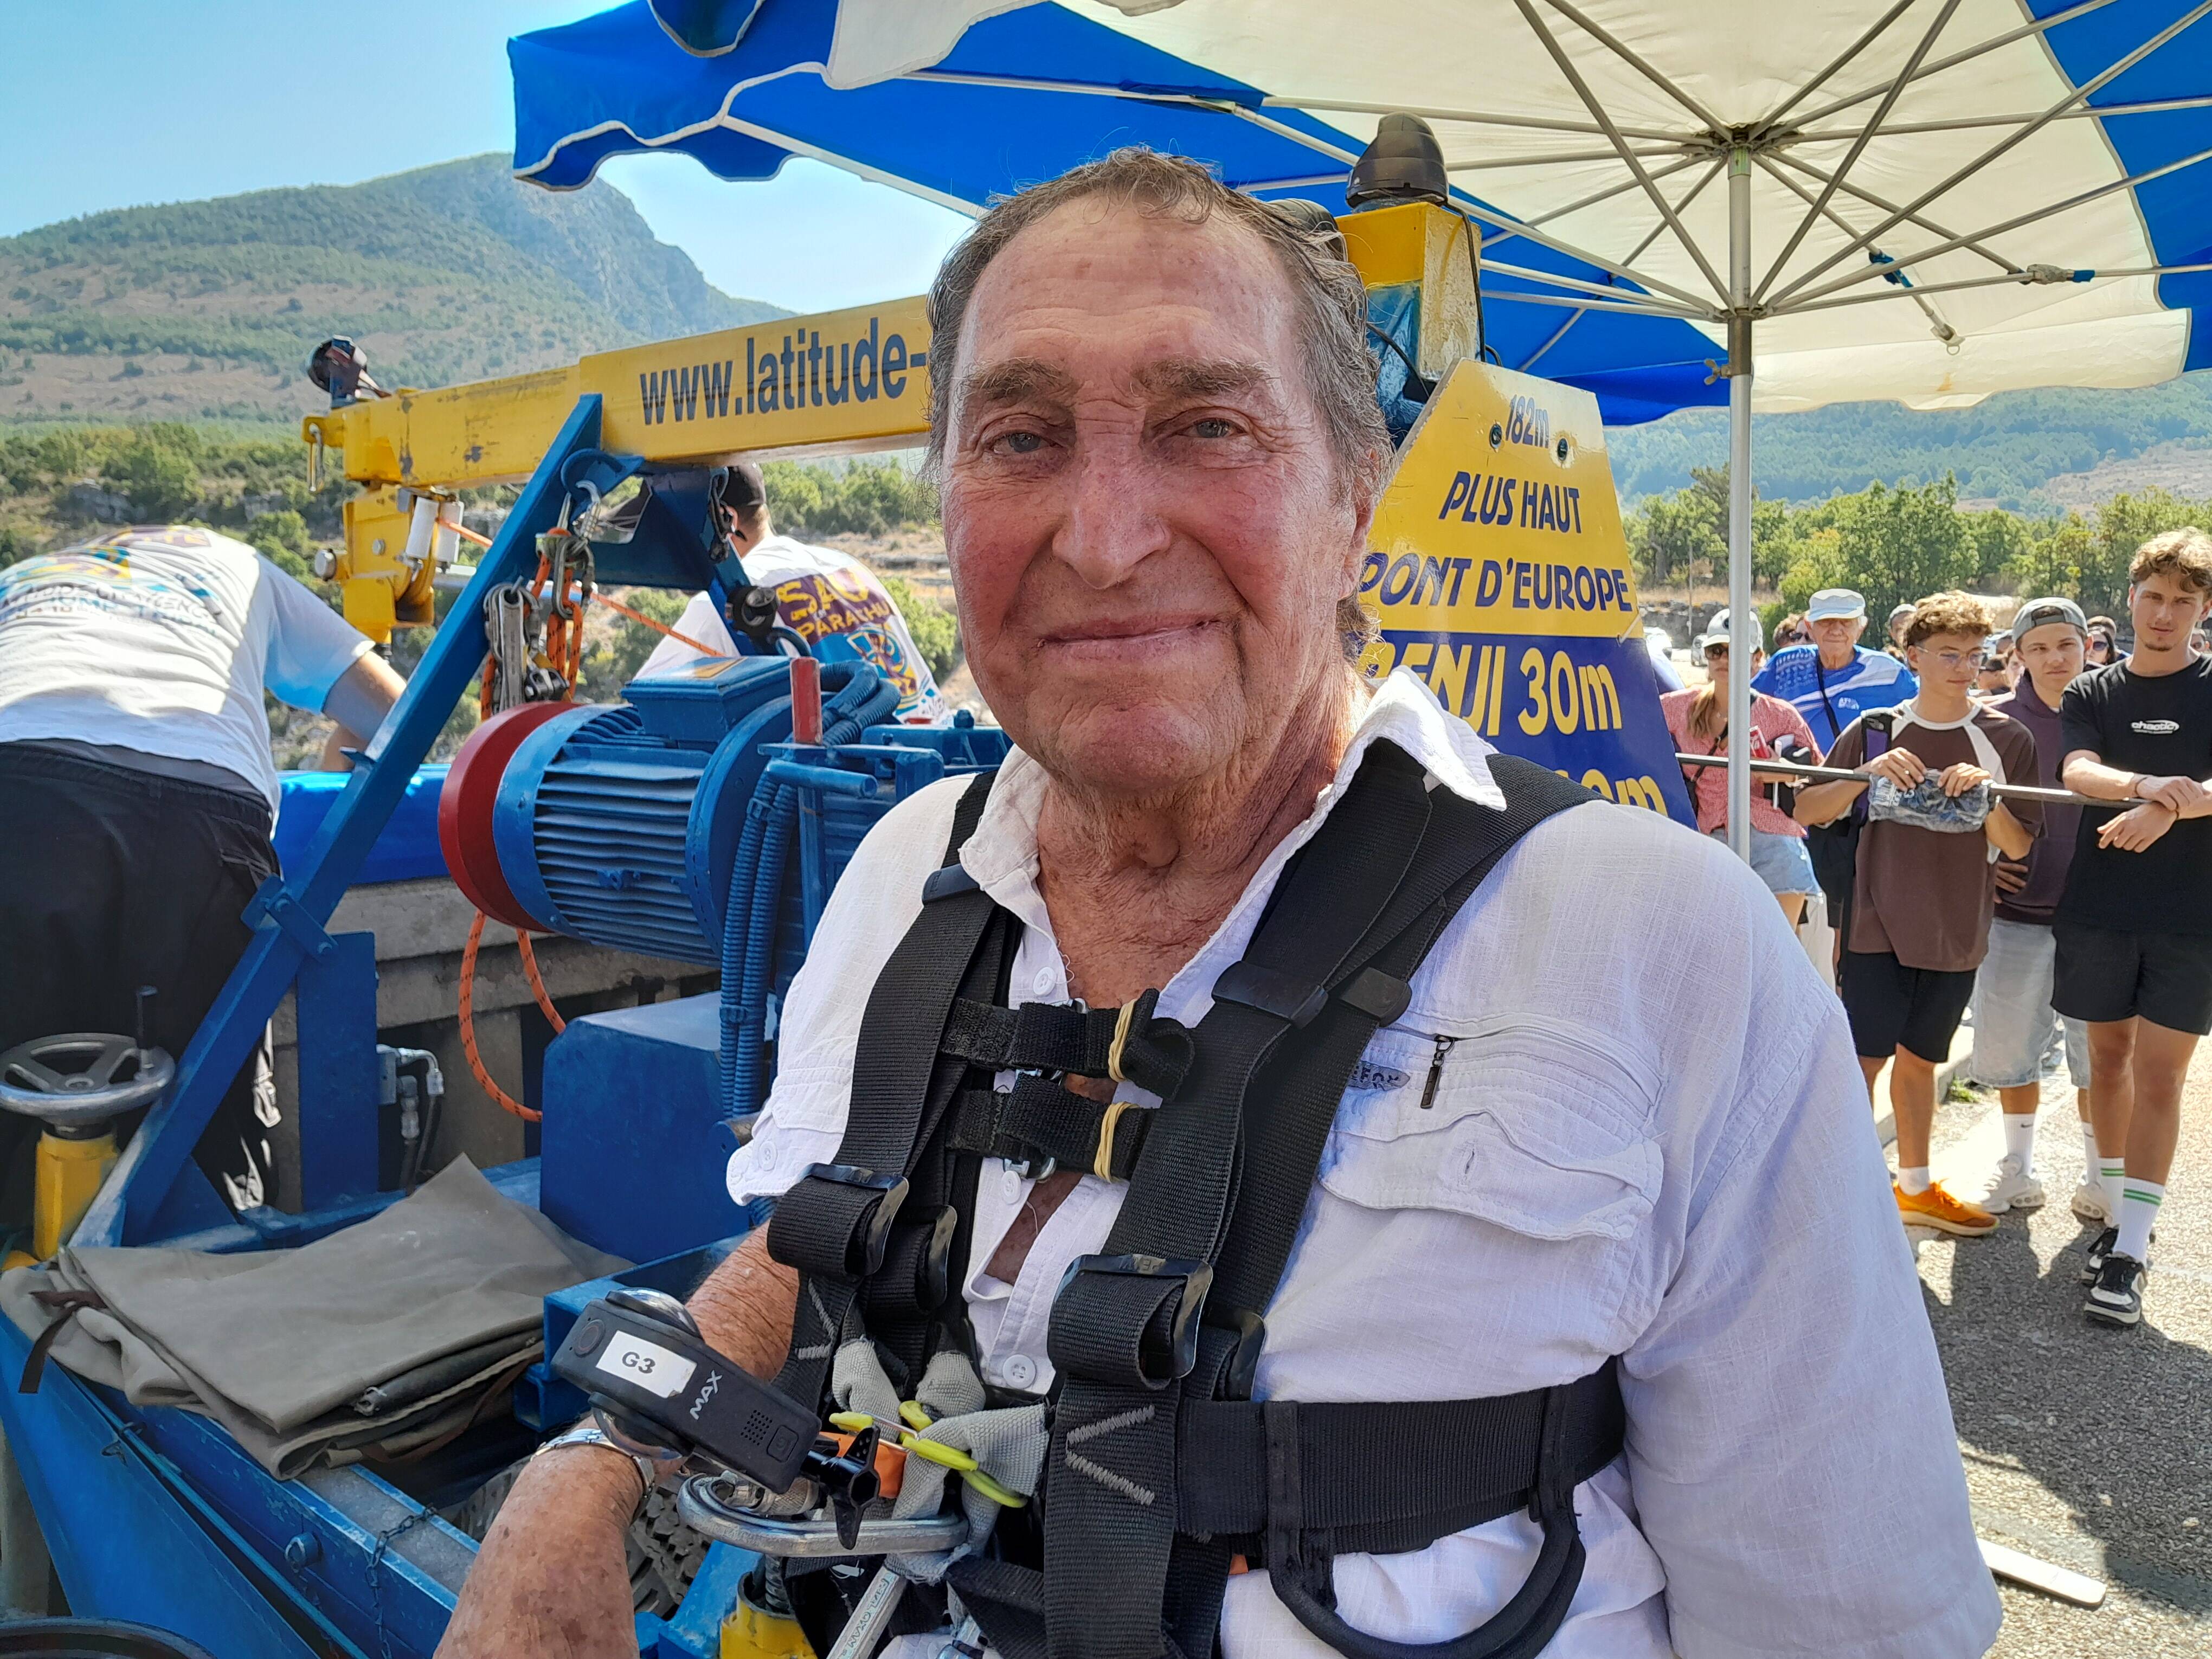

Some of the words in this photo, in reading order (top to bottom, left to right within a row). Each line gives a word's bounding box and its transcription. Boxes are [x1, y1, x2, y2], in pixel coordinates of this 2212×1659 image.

[1506, 394, 1549, 449] 182m
[1438, 471, 1516, 525] PLUS
[1520, 480, 1581, 533] HAUT
[1359, 552, 1472, 606] PONT
[1475, 557, 1633, 612] D'EUROPE
[1518, 647, 1623, 736] 30m
[622, 1352, 656, 1374] G3
[689, 1369, 723, 1420] MAX
